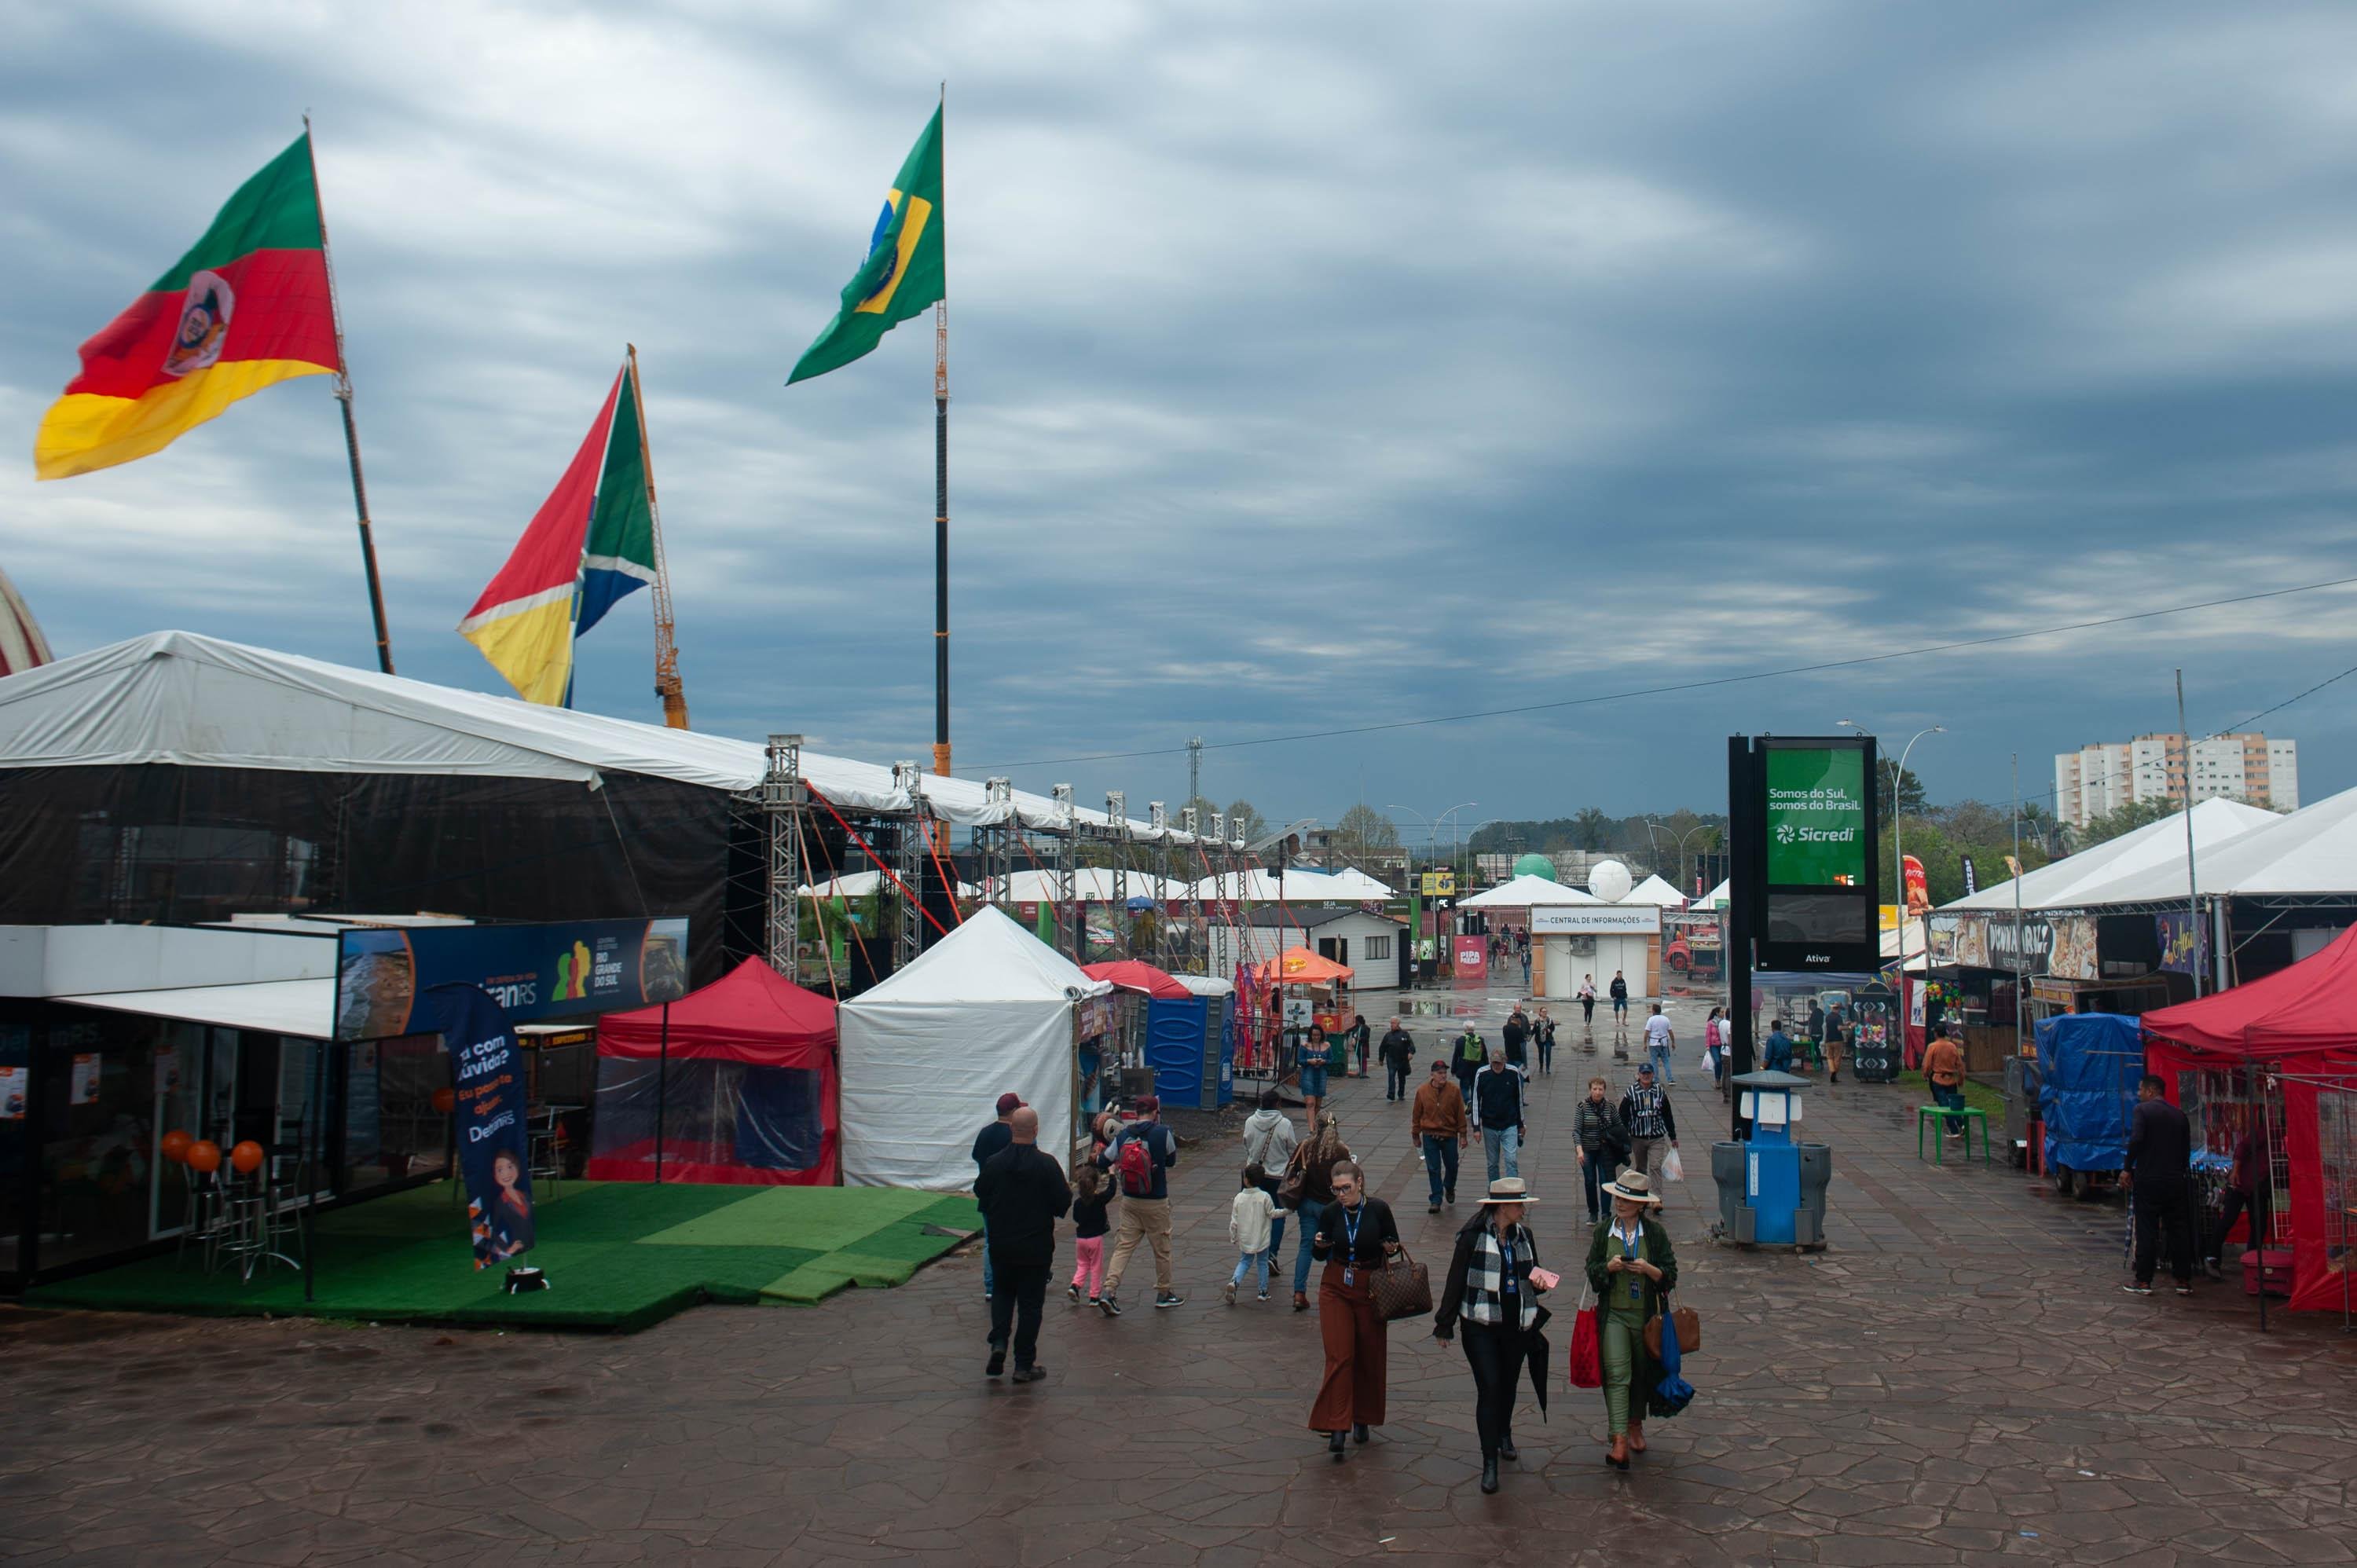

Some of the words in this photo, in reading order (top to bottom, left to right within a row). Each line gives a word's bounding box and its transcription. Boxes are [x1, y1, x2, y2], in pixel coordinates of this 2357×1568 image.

[1769, 789, 1808, 798] Somos
[1809, 789, 1824, 798] do
[1826, 788, 1847, 800] Sul,
[1769, 801, 1807, 810] somos
[1809, 800, 1824, 810] do
[1825, 800, 1861, 810] Brasil.
[1798, 827, 1854, 841] Sicredi
[1592, 915, 1640, 925] INFORMAÇÕES
[596, 951, 609, 963] RIO
[1805, 954, 1830, 962] Ativa
[595, 962, 622, 975] GRANDE
[594, 976, 605, 987] DO
[606, 974, 618, 987] SUL
[472, 1035, 506, 1057] com
[459, 1050, 510, 1081] úvida?
